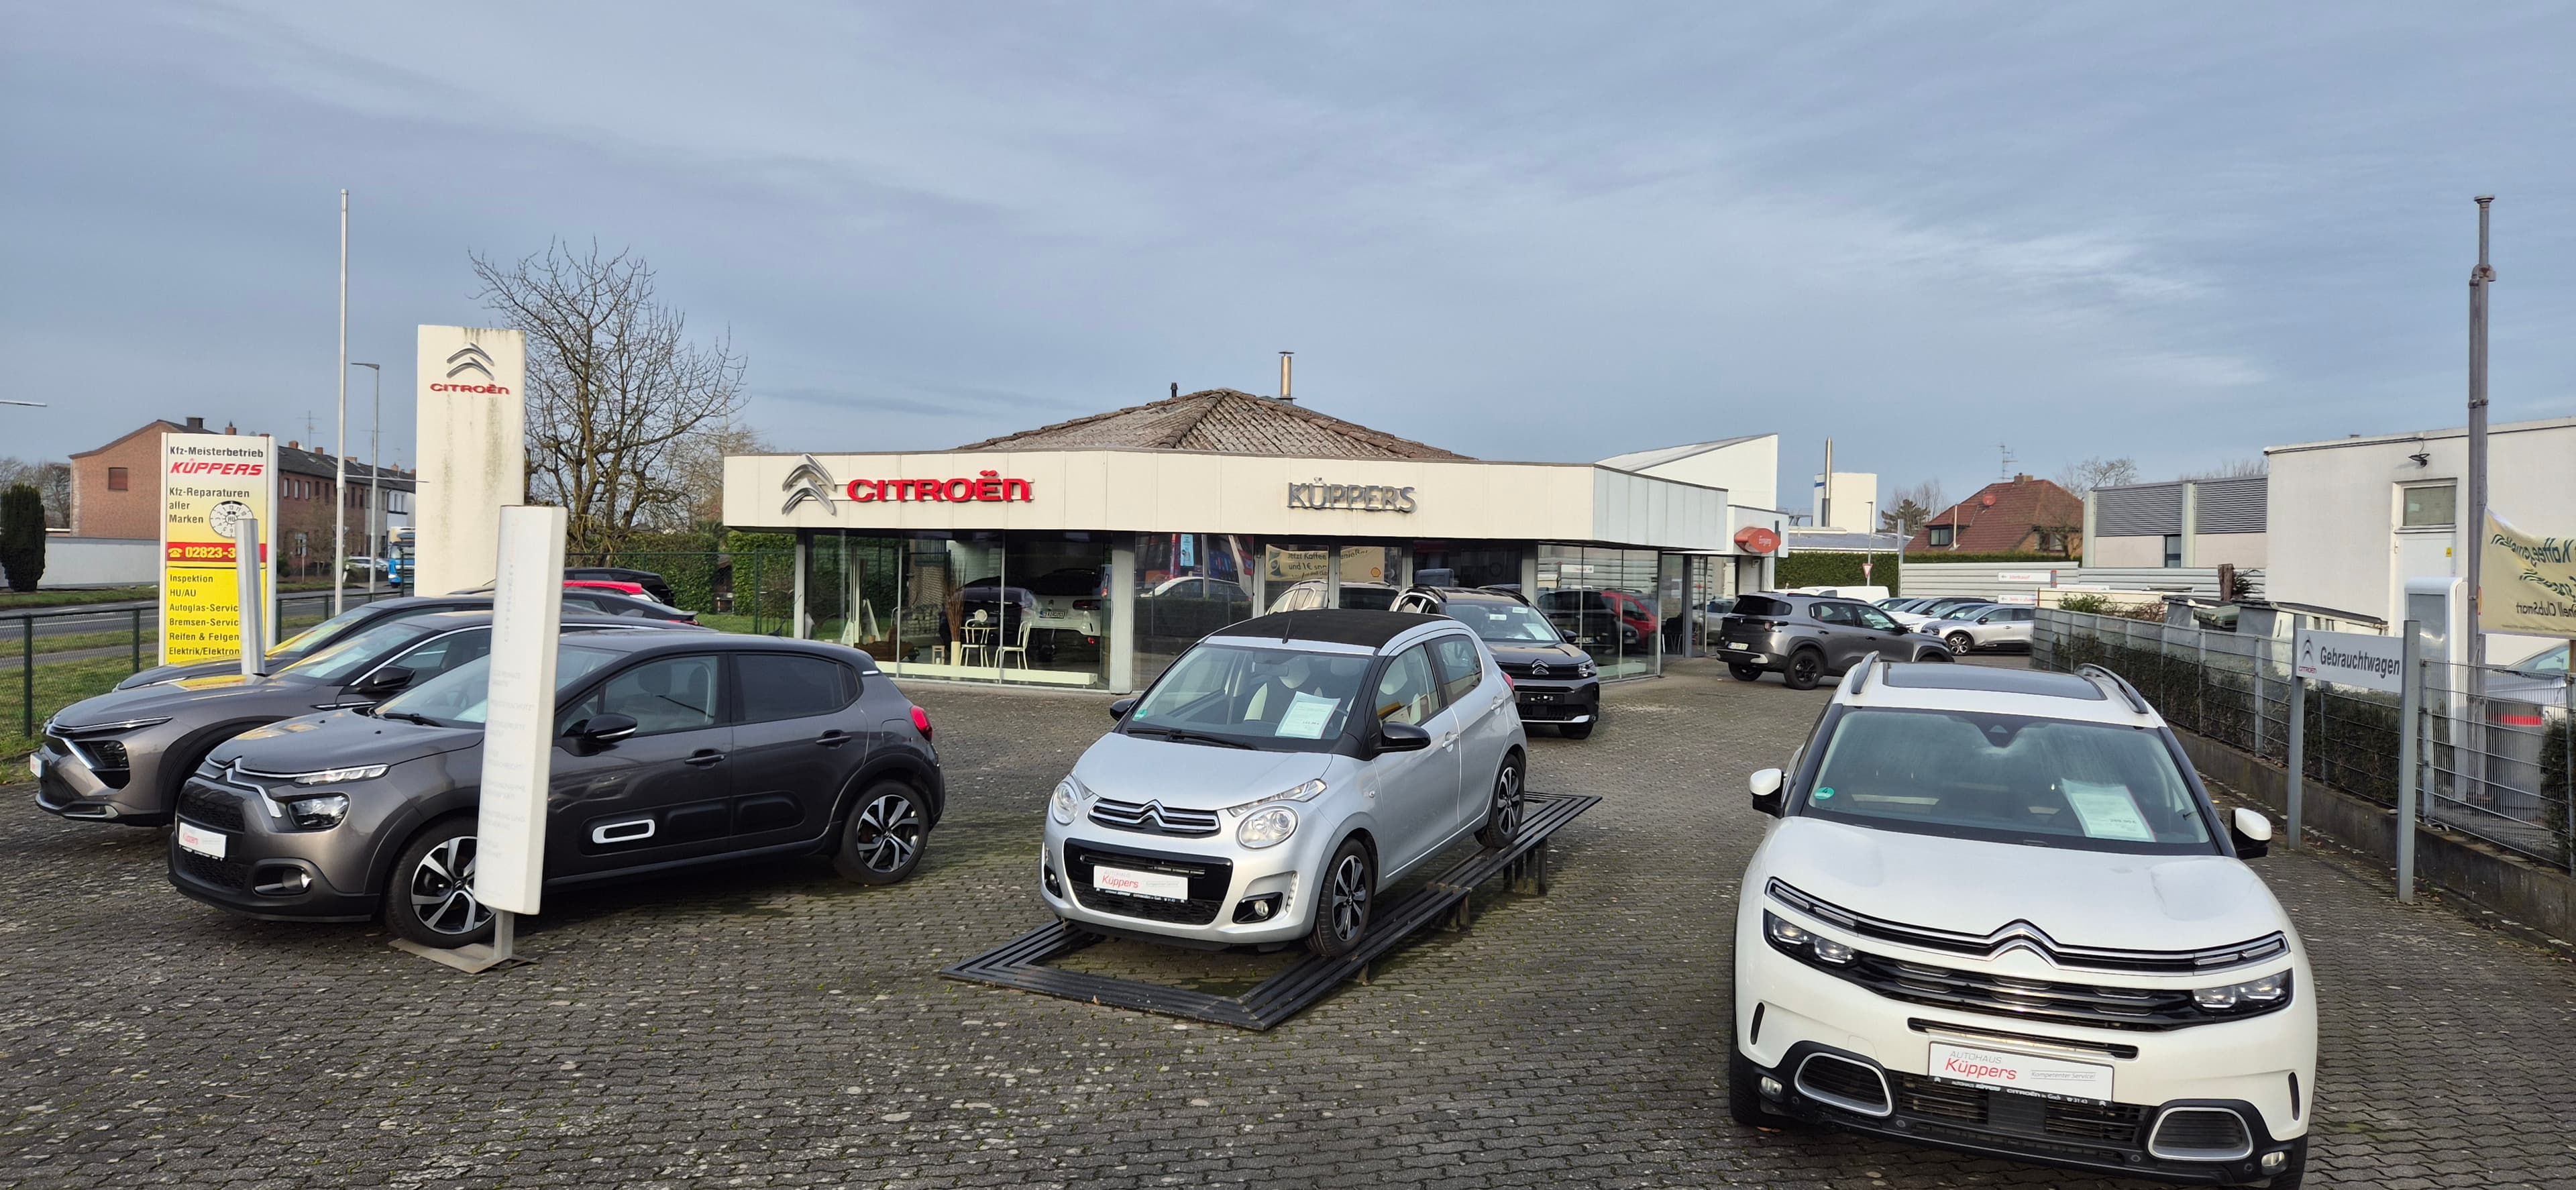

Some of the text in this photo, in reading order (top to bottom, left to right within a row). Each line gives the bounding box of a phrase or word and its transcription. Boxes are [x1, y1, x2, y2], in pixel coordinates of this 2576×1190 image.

[170, 446, 264, 457] Kfz-Meisterbetrieb
[170, 458, 264, 476] KÜPPERS
[170, 487, 250, 498] Kfz-Reparaturen
[1287, 477, 1417, 513] KÜPPERS
[169, 501, 190, 510] aller
[169, 515, 204, 524] Marken
[184, 546, 236, 558] 02823-3
[170, 574, 213, 584] Inspektion
[170, 589, 197, 597] HU/AU
[170, 603, 239, 613] Autoglas-Servic
[169, 617, 239, 627] Bremsen-Servic
[169, 632, 239, 643] Reifen & Felgen
[169, 647, 240, 656] Elektrik/Elektron
[2320, 646, 2400, 679] Gebrauchtwagen
[1950, 1051, 2002, 1064] AUTOHAUS
[1945, 1058, 2018, 1080] Küppers
